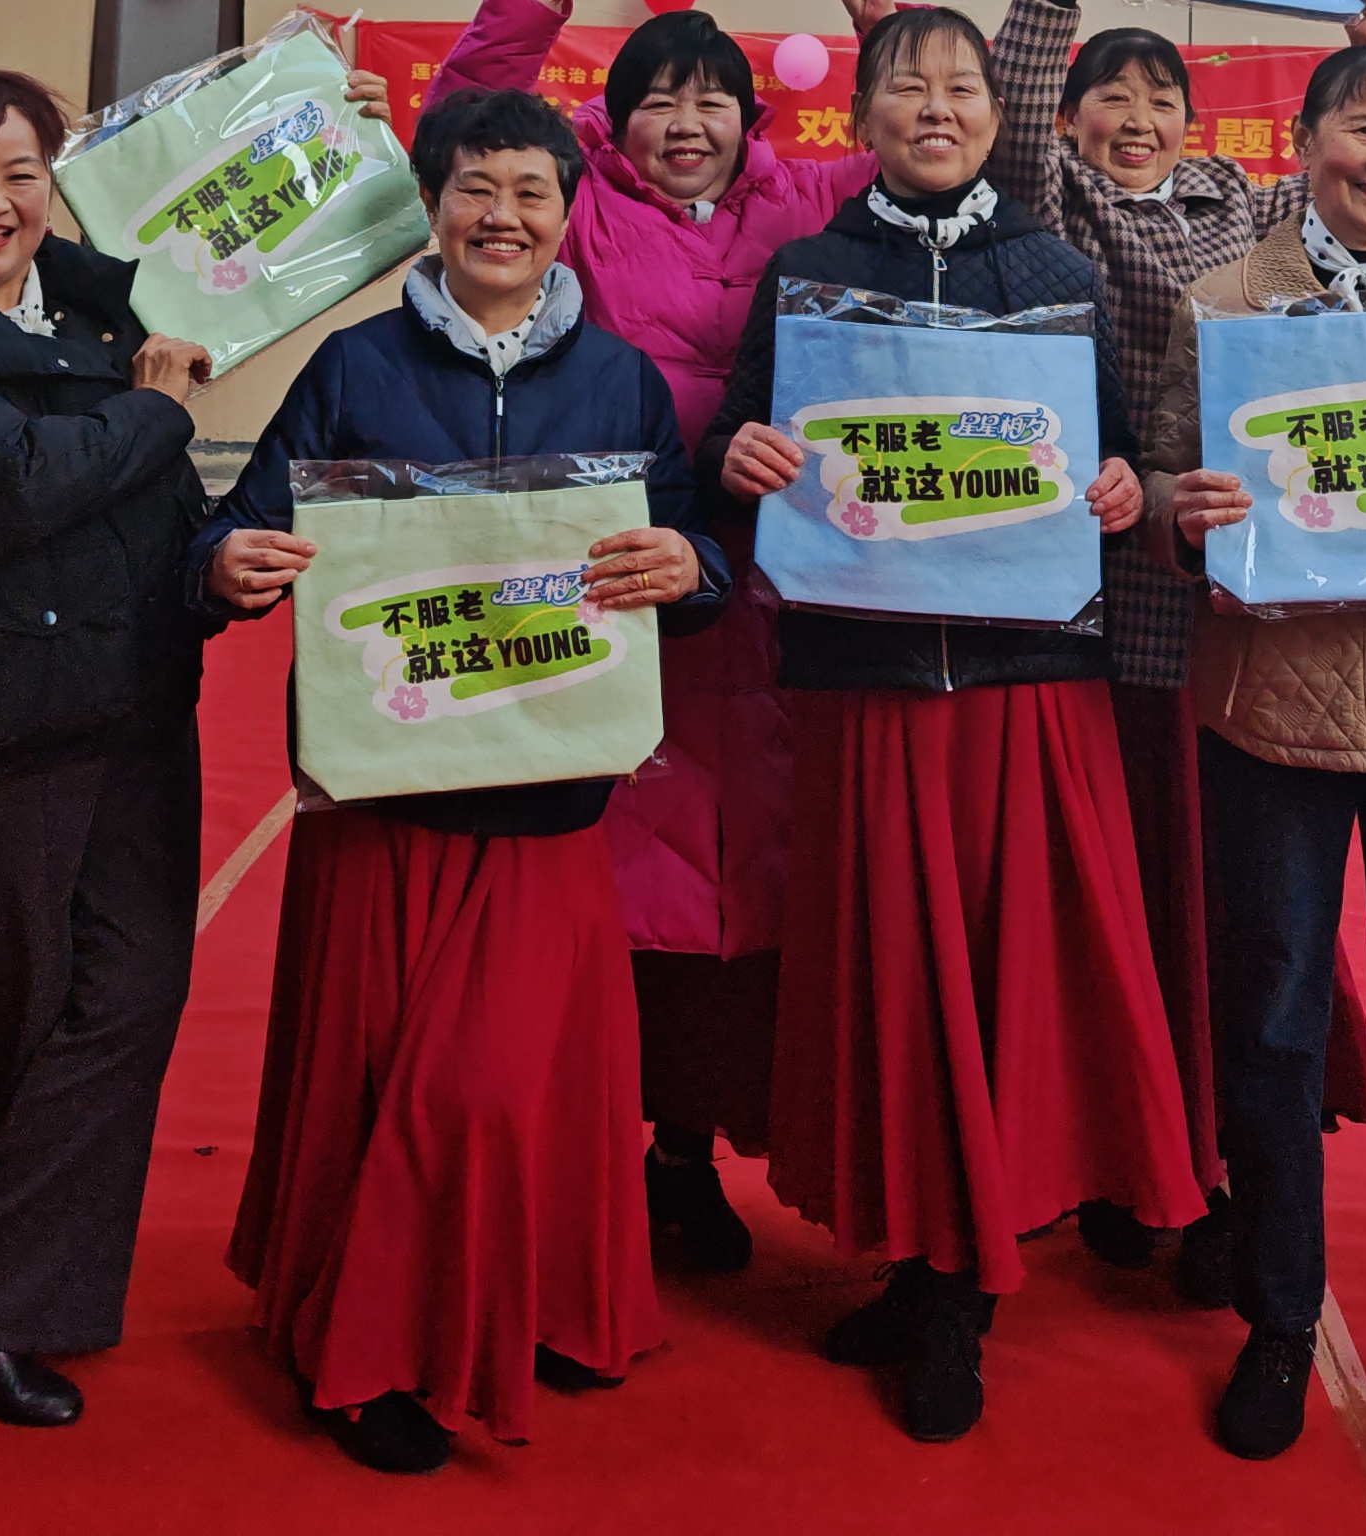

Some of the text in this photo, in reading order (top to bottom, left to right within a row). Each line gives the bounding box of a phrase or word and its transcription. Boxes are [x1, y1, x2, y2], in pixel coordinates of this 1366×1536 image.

[411, 62, 441, 81] 莲
[538, 66, 587, 85] 共治
[167, 161, 254, 231] 不服老
[841, 420, 942, 454] 不服老
[381, 590, 486, 636] 不服老
